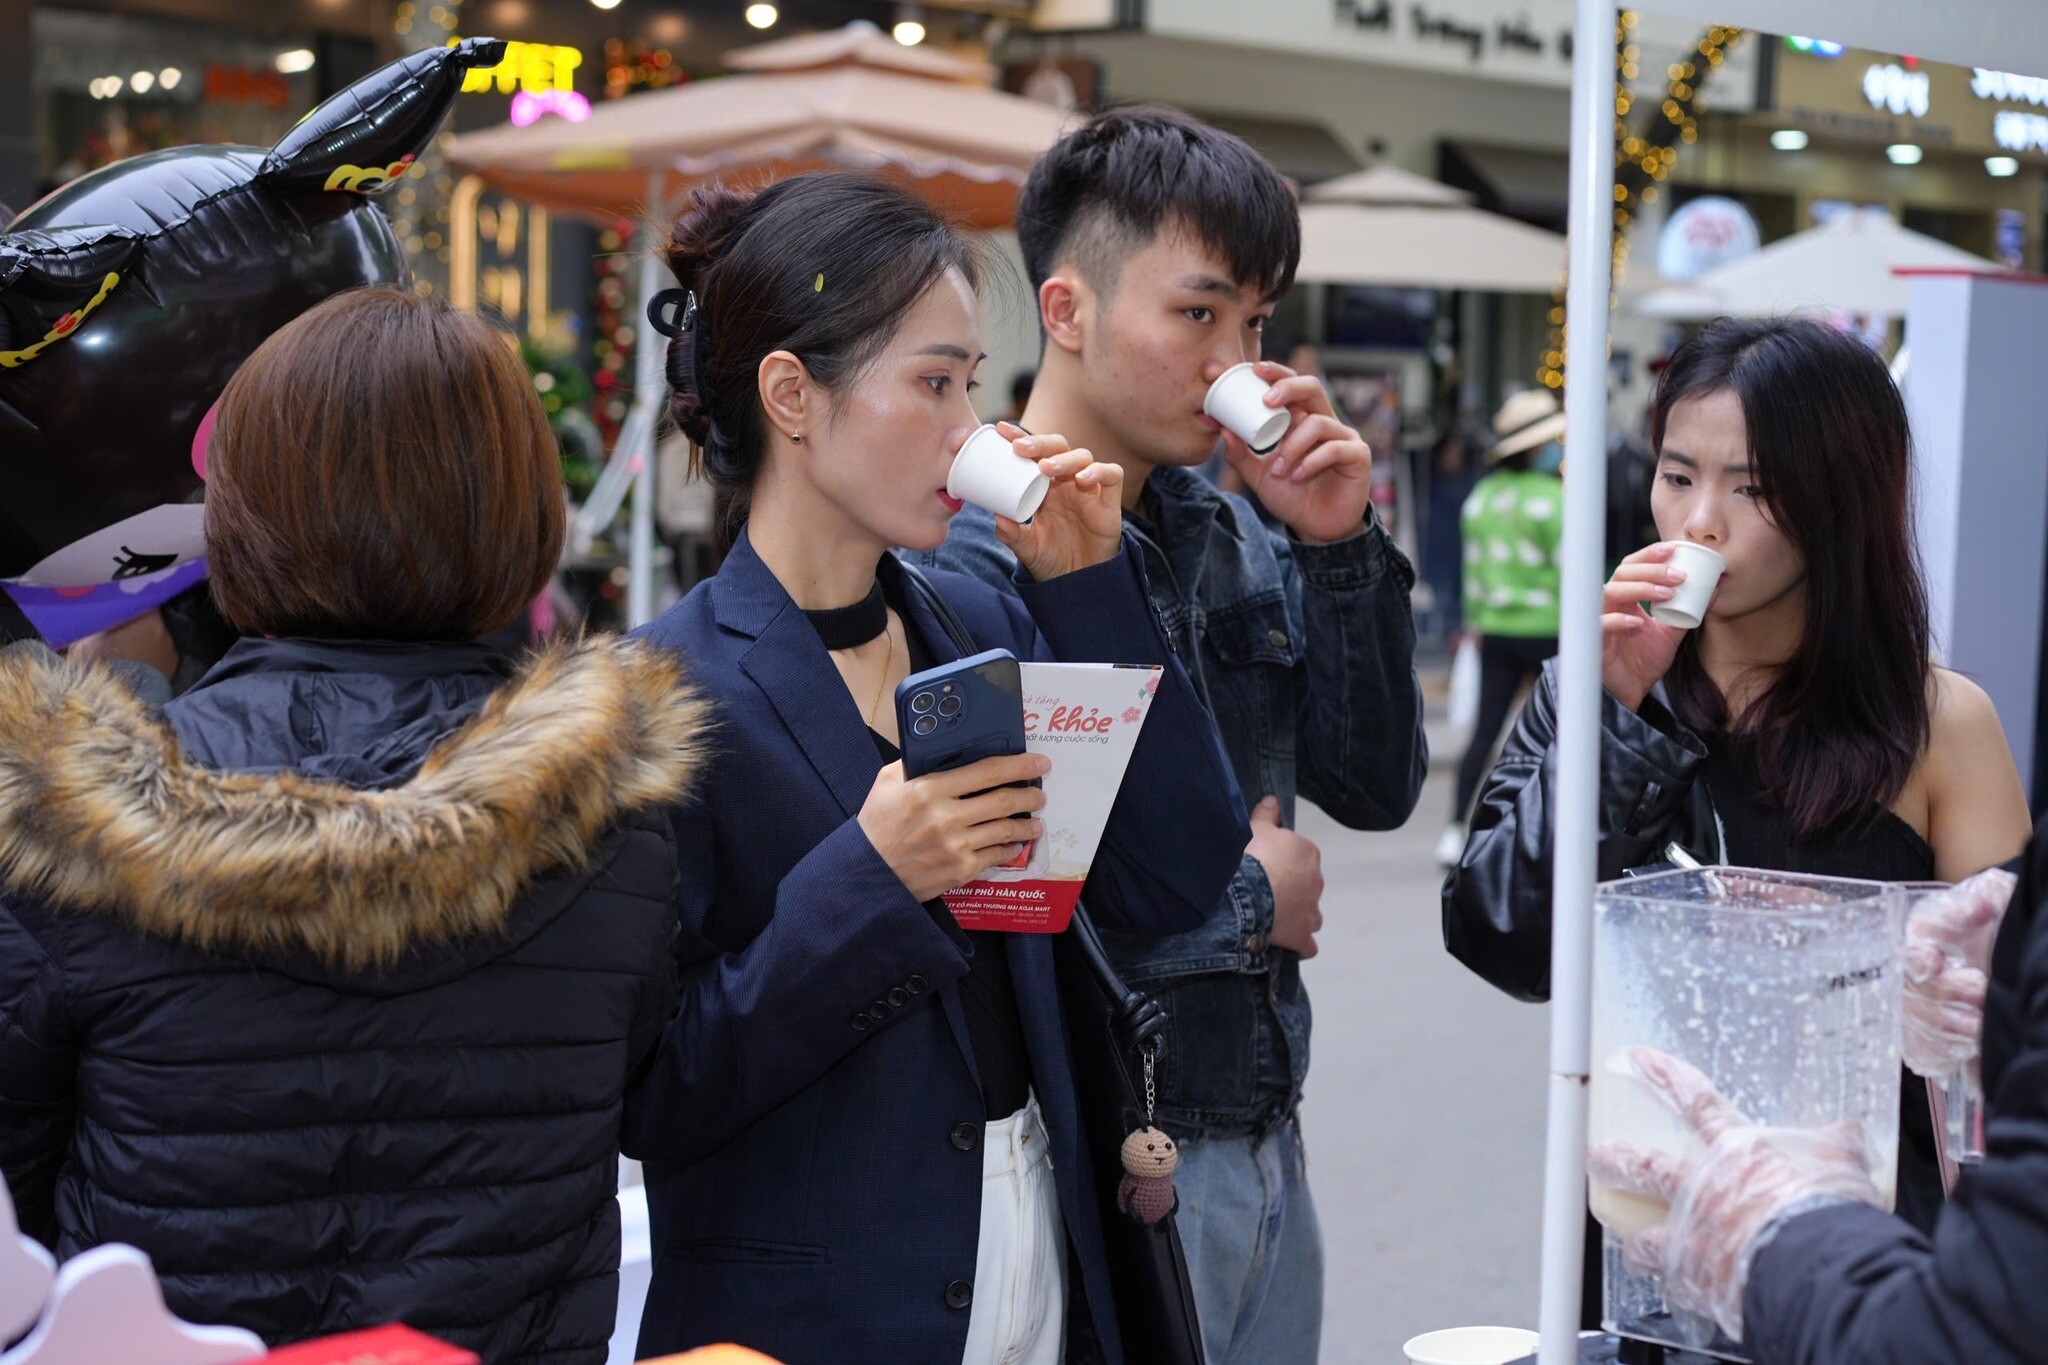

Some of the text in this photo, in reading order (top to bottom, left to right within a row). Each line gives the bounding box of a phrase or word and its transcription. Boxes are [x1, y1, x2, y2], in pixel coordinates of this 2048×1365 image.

[1047, 705, 1113, 733] khỏe
[1039, 734, 1063, 743] lượng
[1064, 734, 1087, 743] cuộc
[1088, 734, 1109, 744] sống
[974, 886, 993, 896] PHỦ
[995, 887, 1017, 898] HÀN
[1019, 889, 1046, 899] QUỐC
